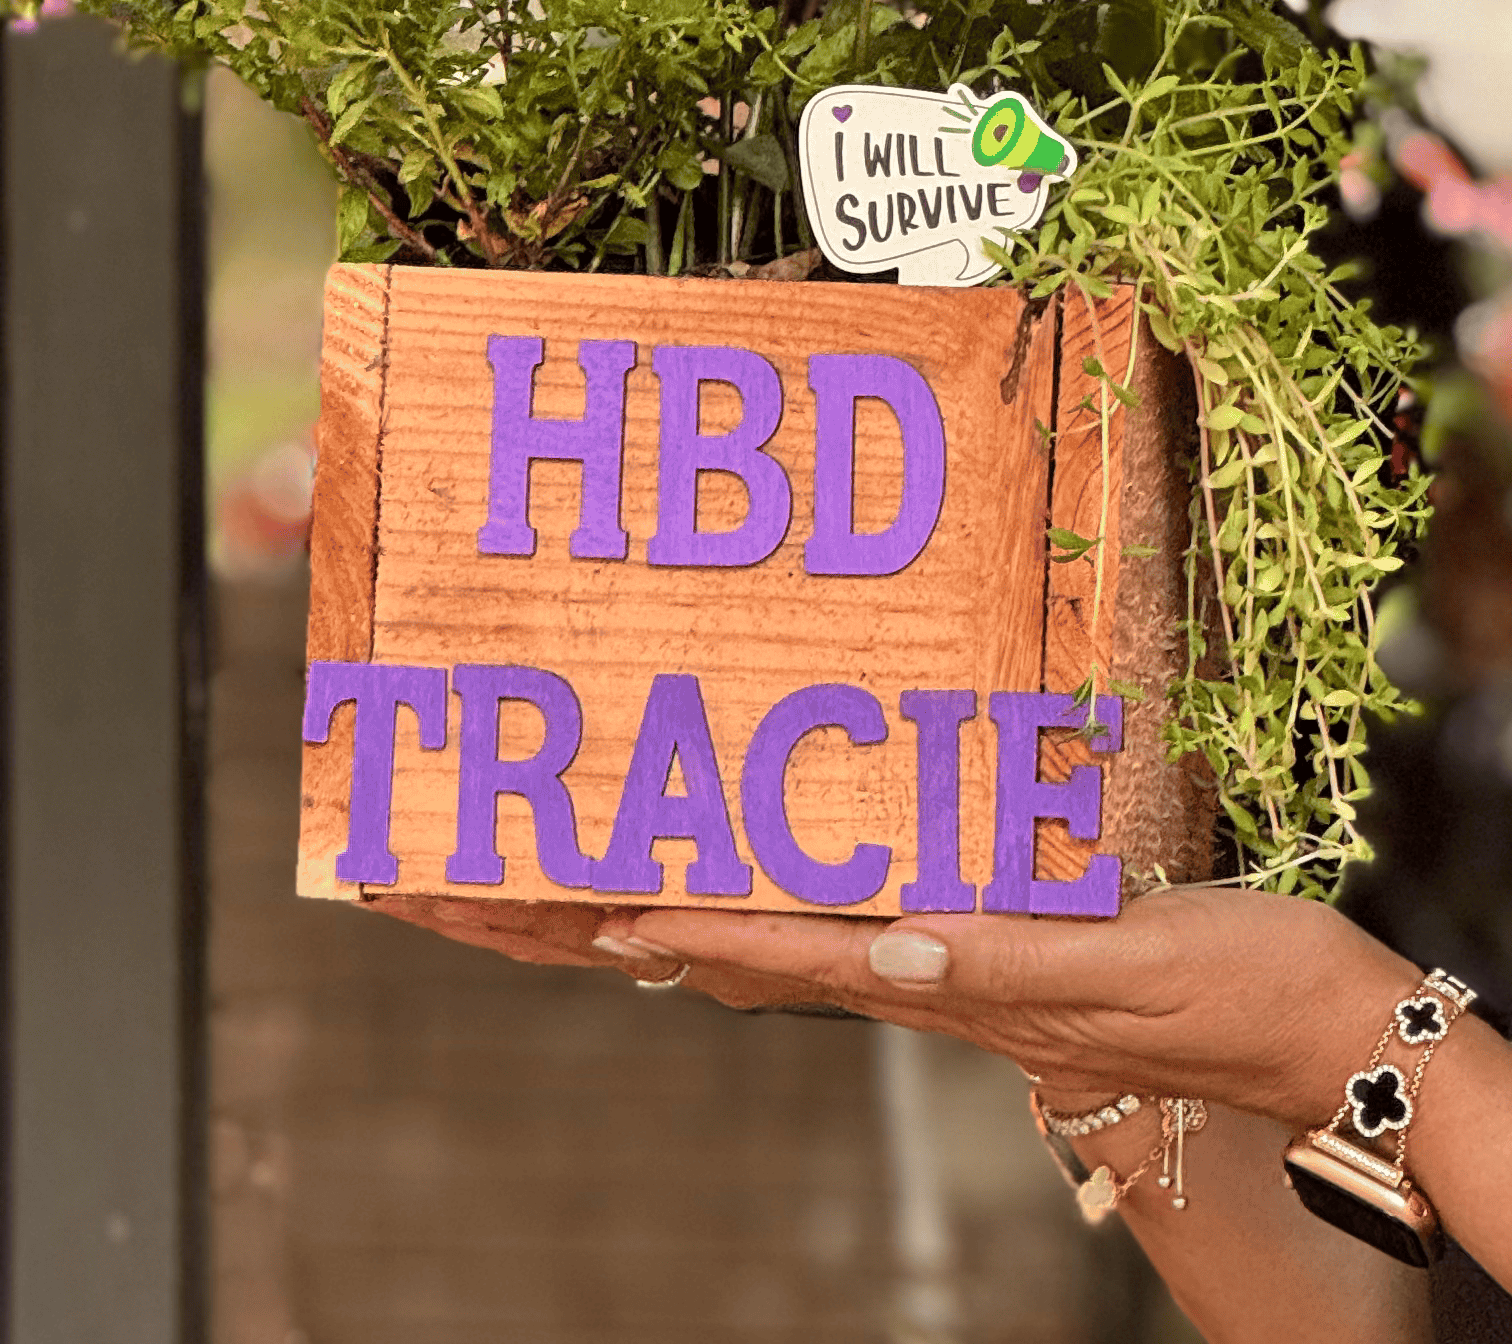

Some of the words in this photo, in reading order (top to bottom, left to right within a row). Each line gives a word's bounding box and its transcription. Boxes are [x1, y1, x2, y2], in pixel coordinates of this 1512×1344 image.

[834, 131, 845, 182] I
[864, 131, 961, 178] WILL
[834, 182, 1016, 252] SURVIVE
[476, 334, 947, 576] HBD
[302, 660, 1124, 918] TRACIE
